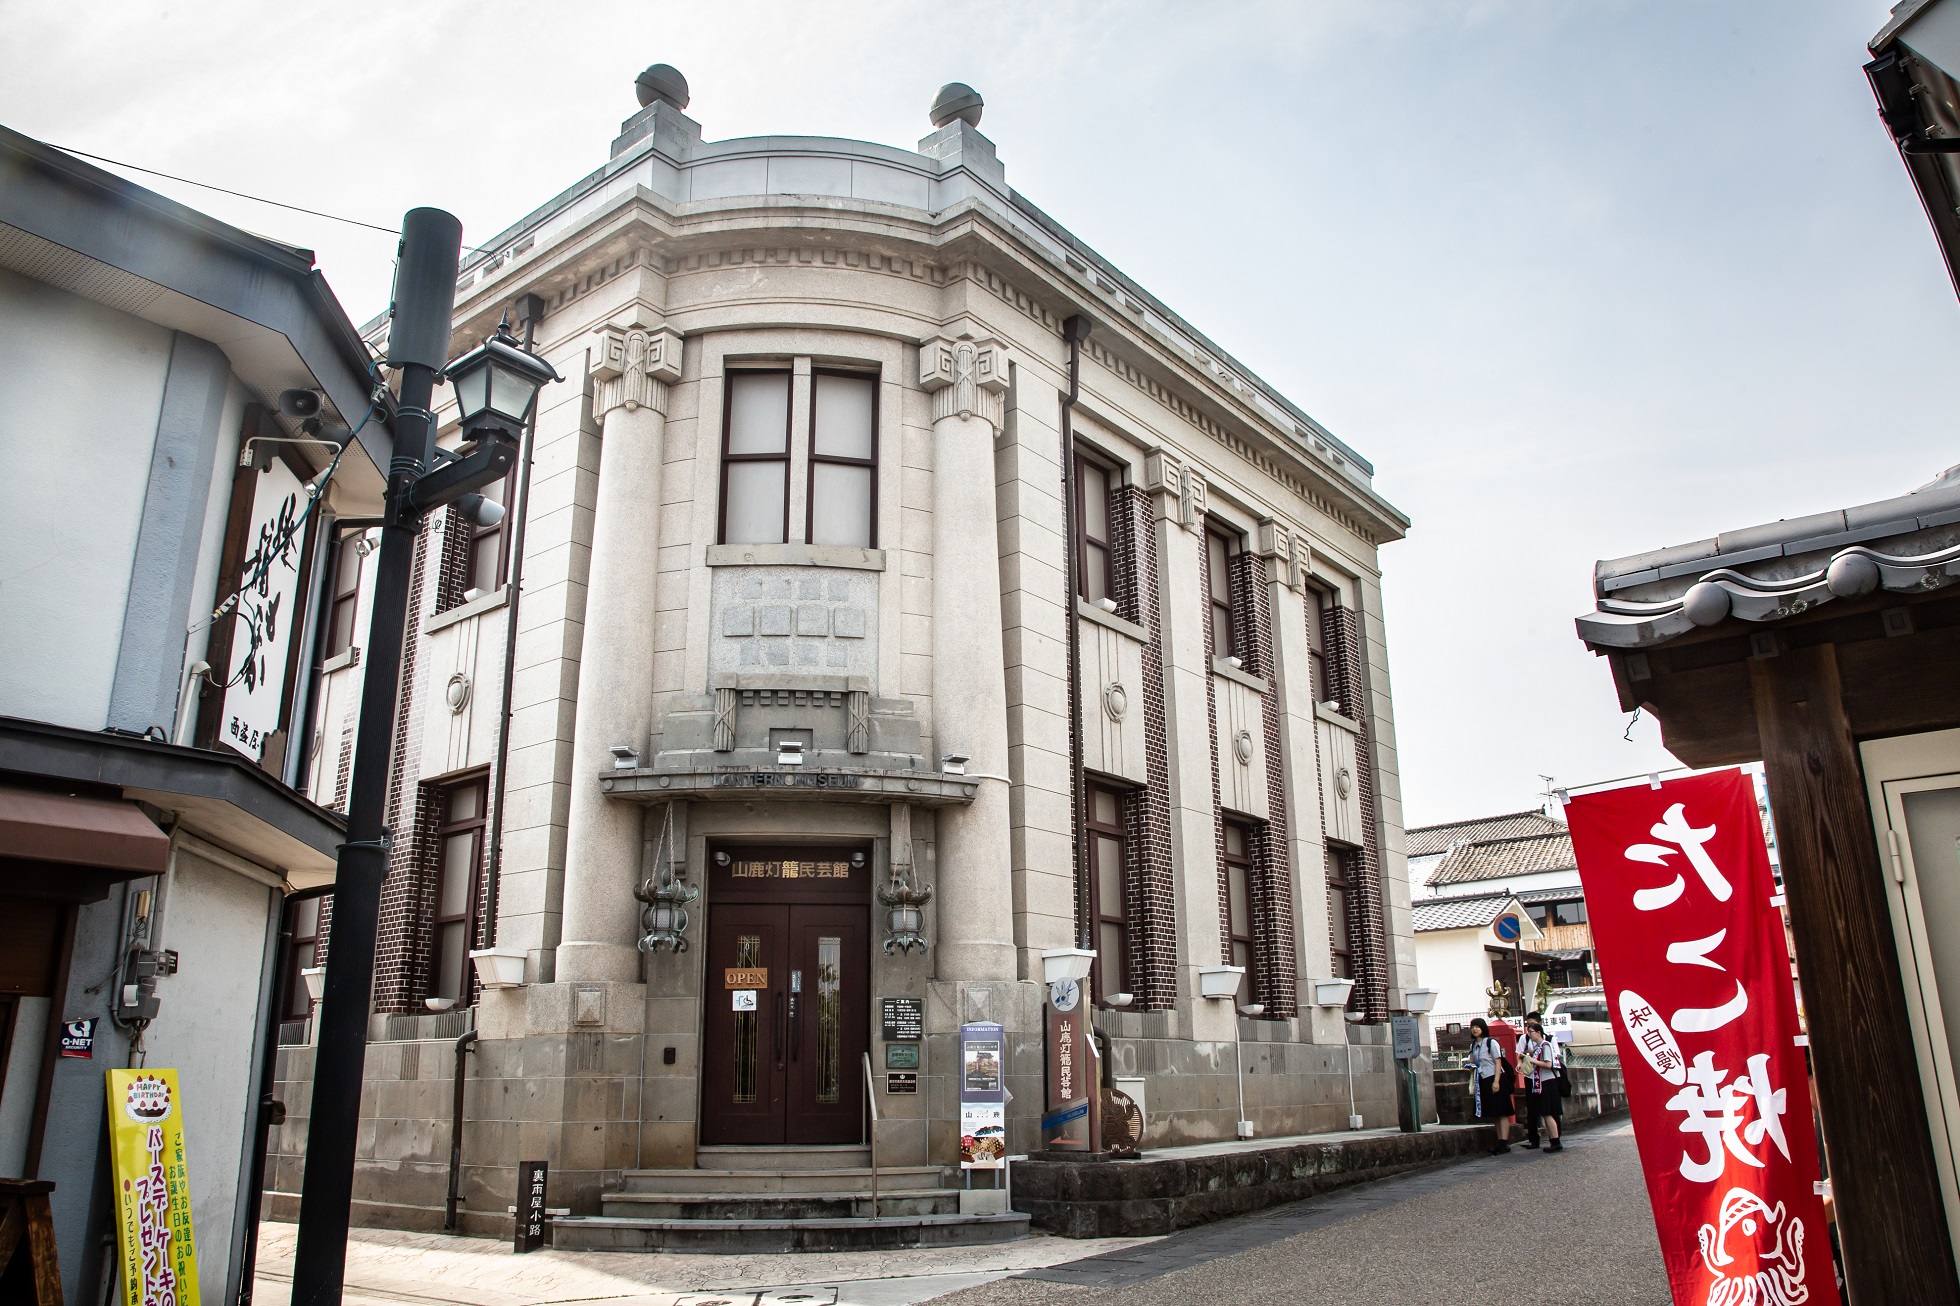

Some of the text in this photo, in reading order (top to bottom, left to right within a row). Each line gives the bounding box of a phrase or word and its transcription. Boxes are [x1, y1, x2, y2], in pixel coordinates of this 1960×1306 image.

[712, 773, 858, 788] LANTERN MUSEUM
[731, 860, 850, 879] 山鹿灯籠民芸館
[726, 972, 767, 985] OPEN
[1059, 1020, 1072, 1099] 山鹿灯籠民芸館
[133, 1091, 165, 1099] BIRTHDAY
[136, 1083, 161, 1092] HAPPY
[174, 1132, 193, 1257] ご家族やお友達の
[147, 1127, 175, 1306] バースデーケーキの
